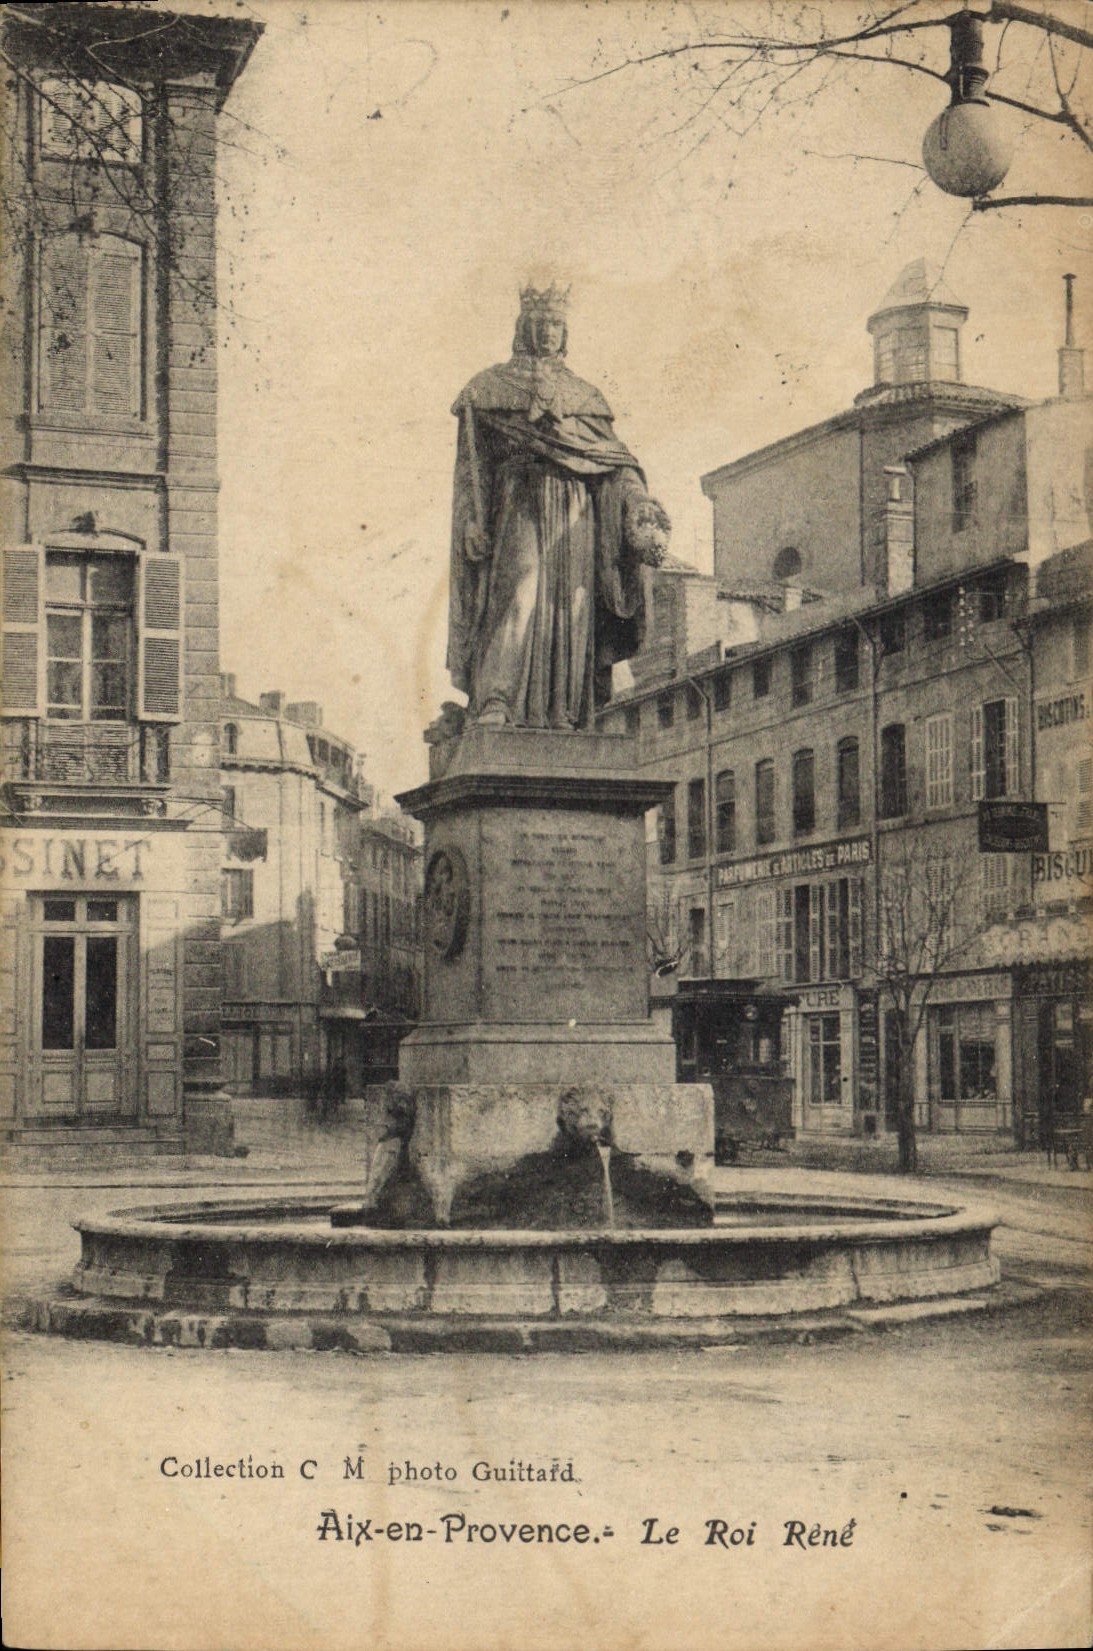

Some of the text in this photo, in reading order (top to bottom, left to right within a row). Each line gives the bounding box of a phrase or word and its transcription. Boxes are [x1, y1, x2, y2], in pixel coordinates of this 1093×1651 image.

[0, 837, 151, 881] SINET
[838, 841, 870, 865] PARIS
[802, 990, 840, 1008] URE
